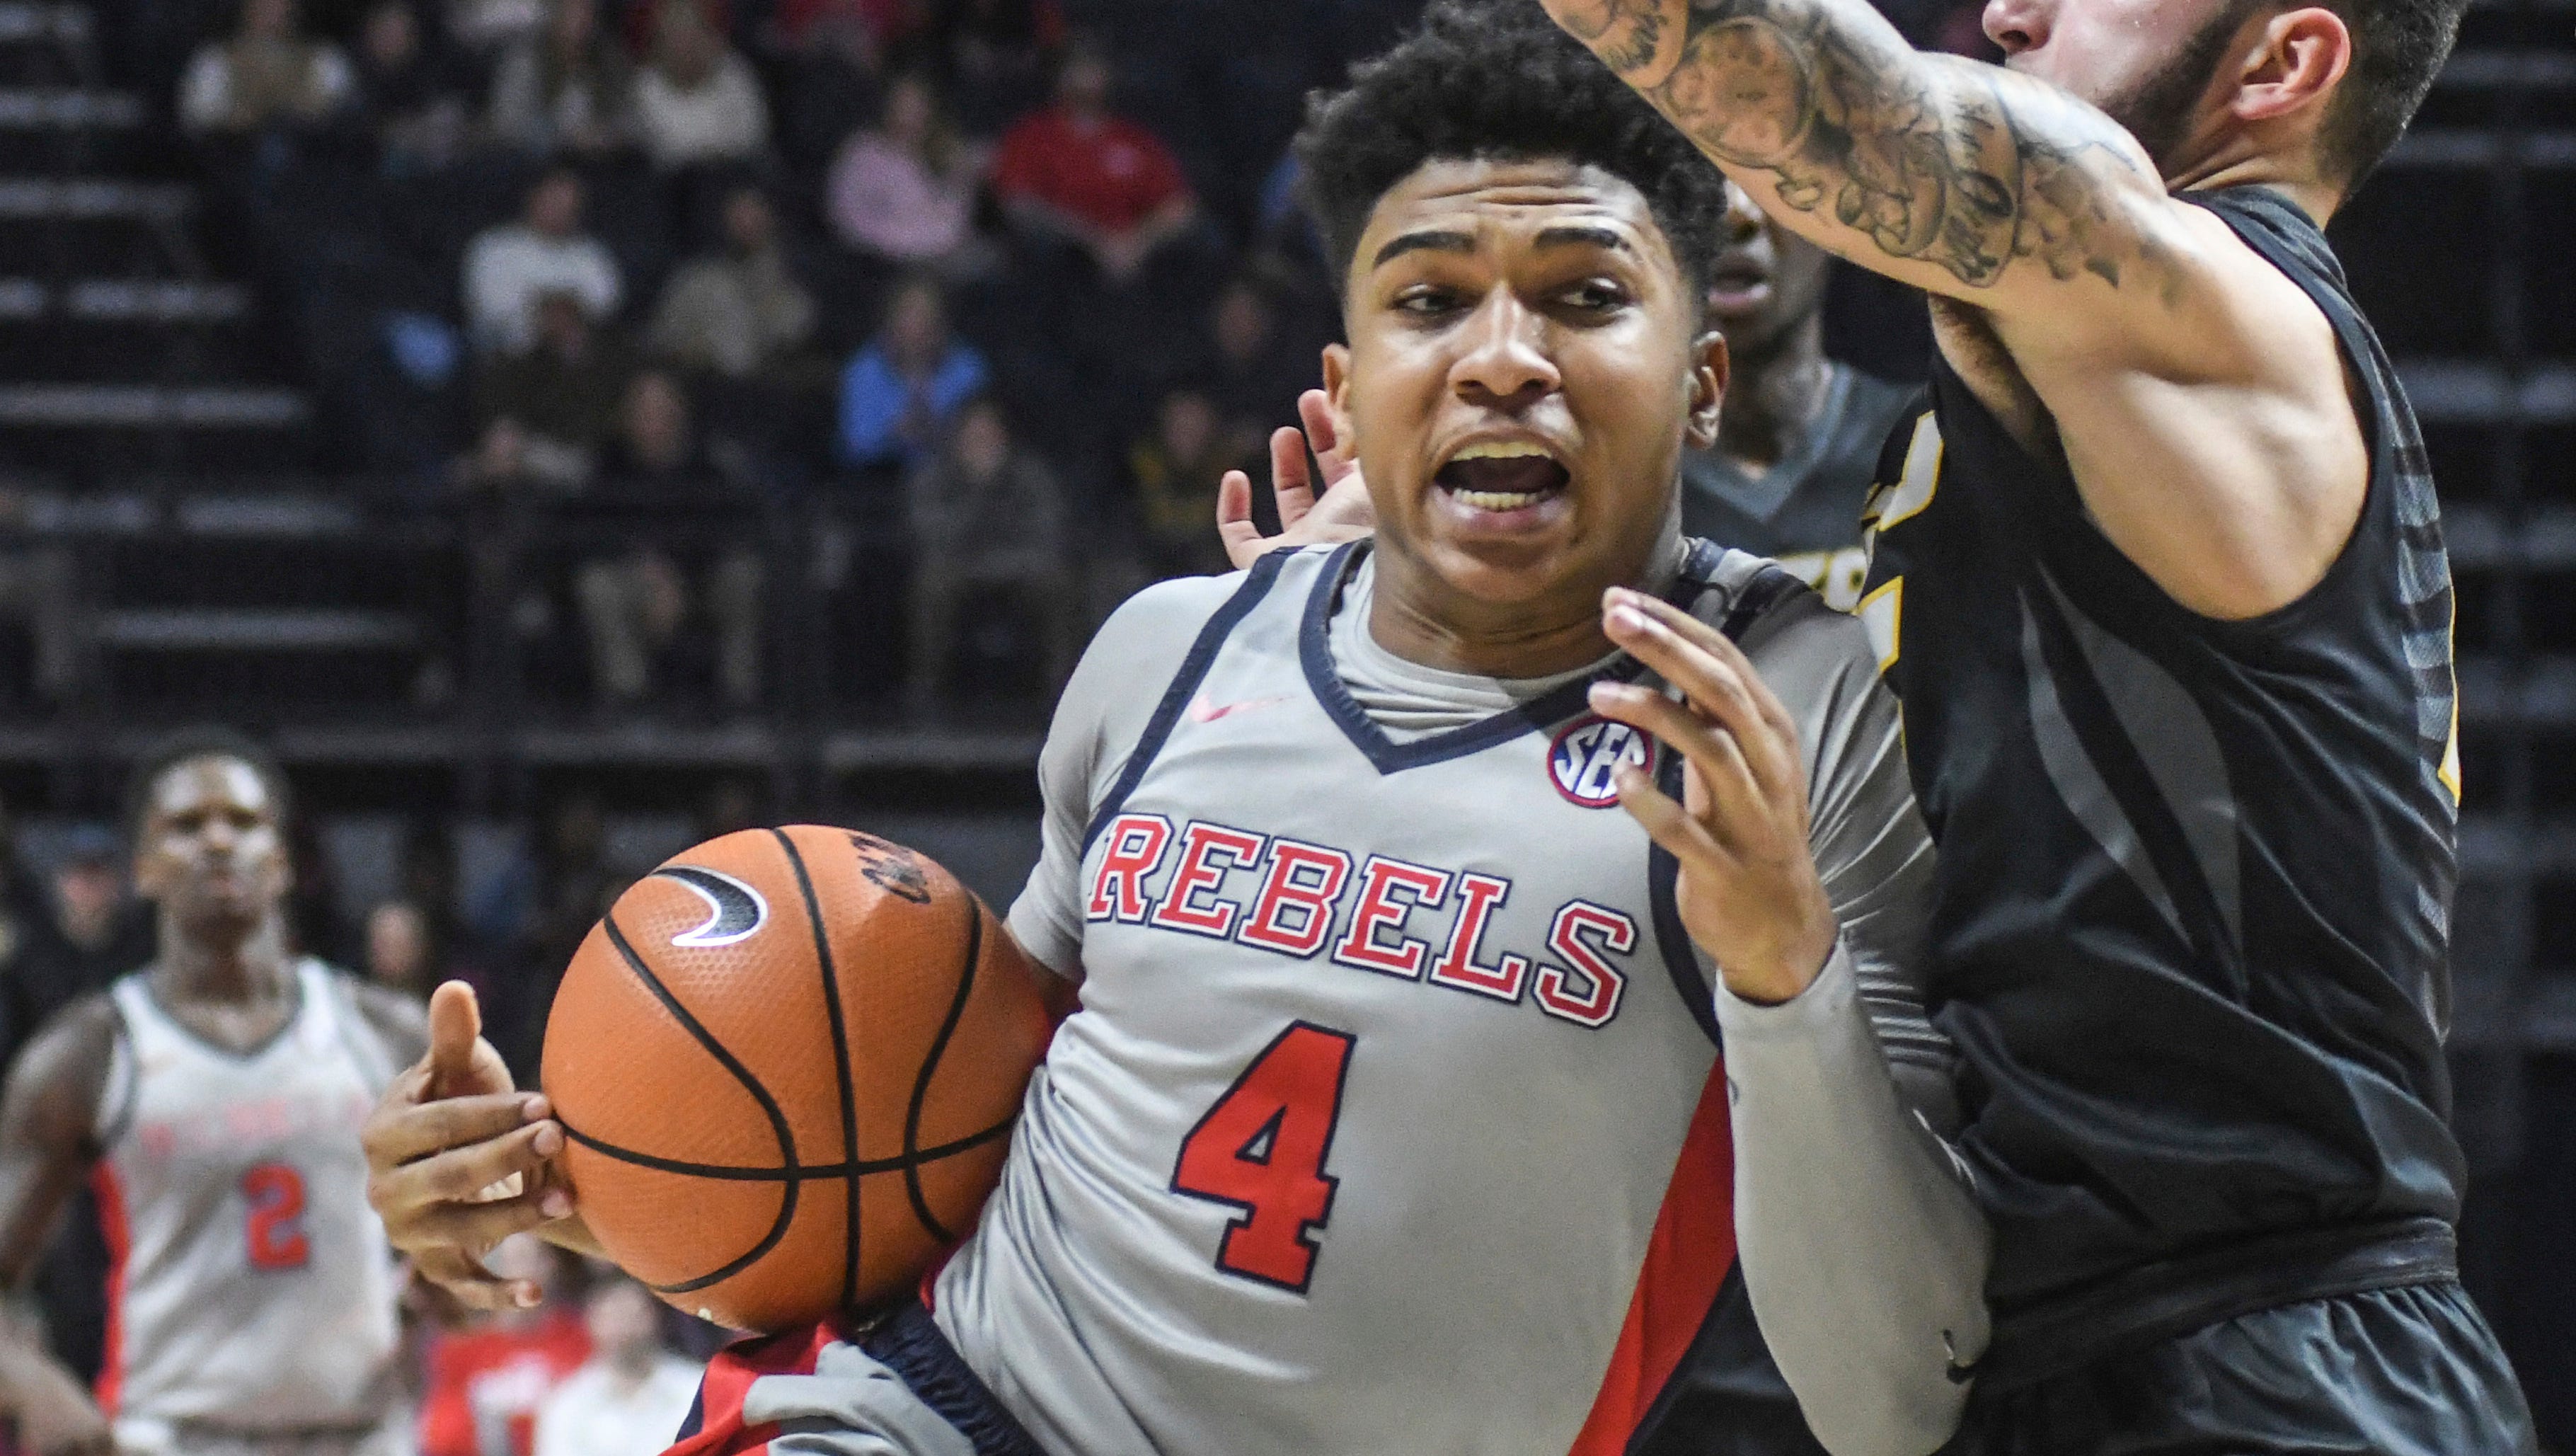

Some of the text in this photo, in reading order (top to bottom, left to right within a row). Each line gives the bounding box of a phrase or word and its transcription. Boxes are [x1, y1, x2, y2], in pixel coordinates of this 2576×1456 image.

[1087, 812, 1639, 1031] REBELS
[241, 1161, 311, 1271] 2
[1170, 1019, 1357, 1295] 4
